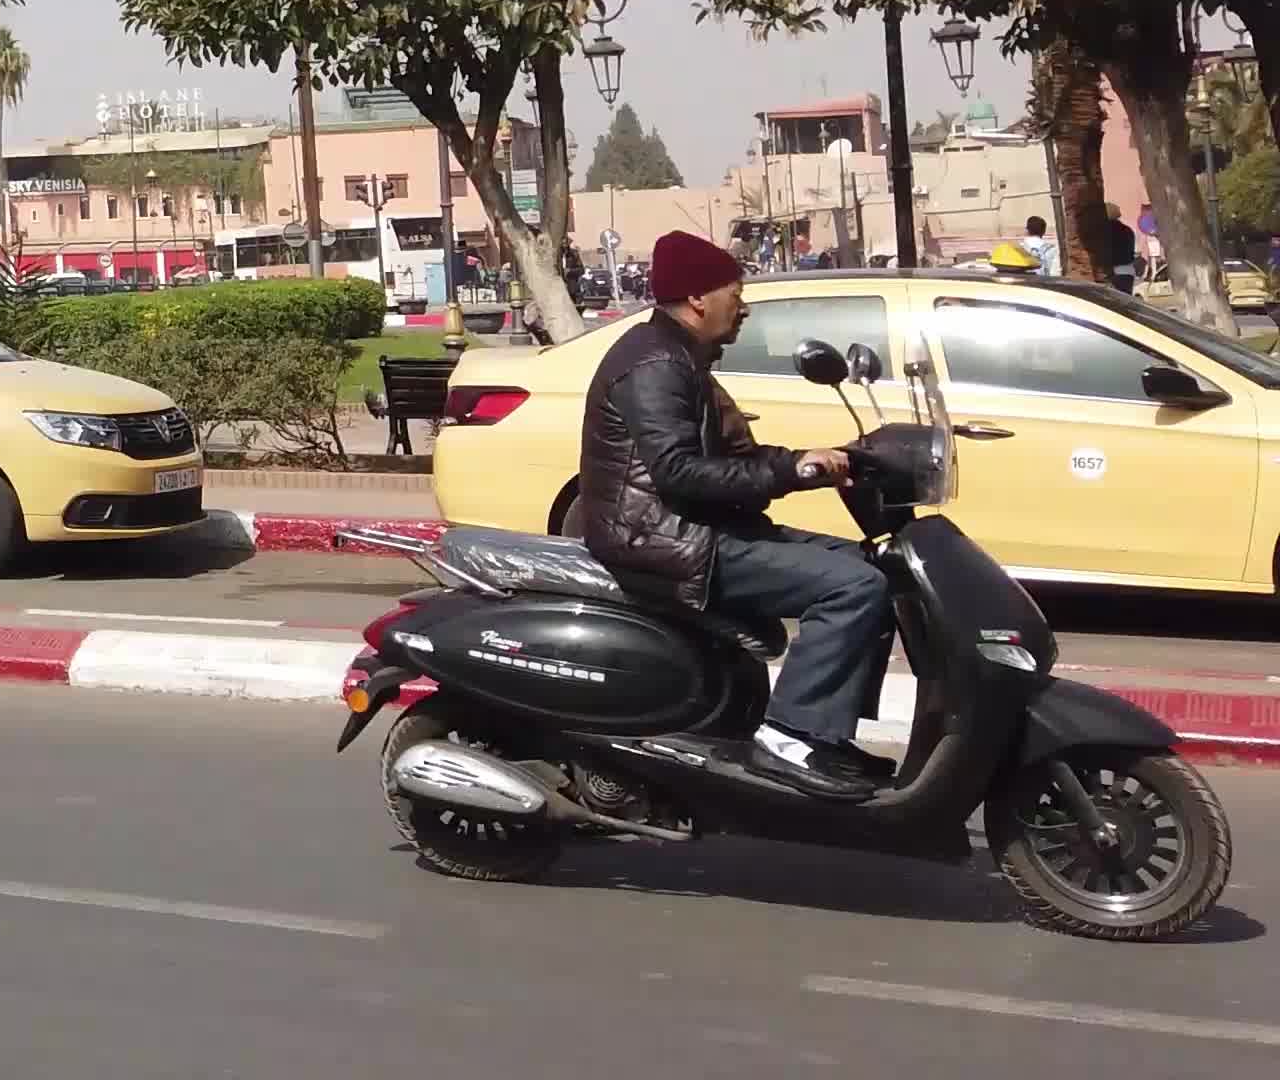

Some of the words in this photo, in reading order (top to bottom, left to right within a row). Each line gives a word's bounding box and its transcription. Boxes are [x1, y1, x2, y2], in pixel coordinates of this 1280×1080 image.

[119, 103, 204, 119] HOTEL
[8, 180, 33, 193] SKY
[34, 178, 86, 192] VENISIA
[1072, 456, 1104, 470] 1657
